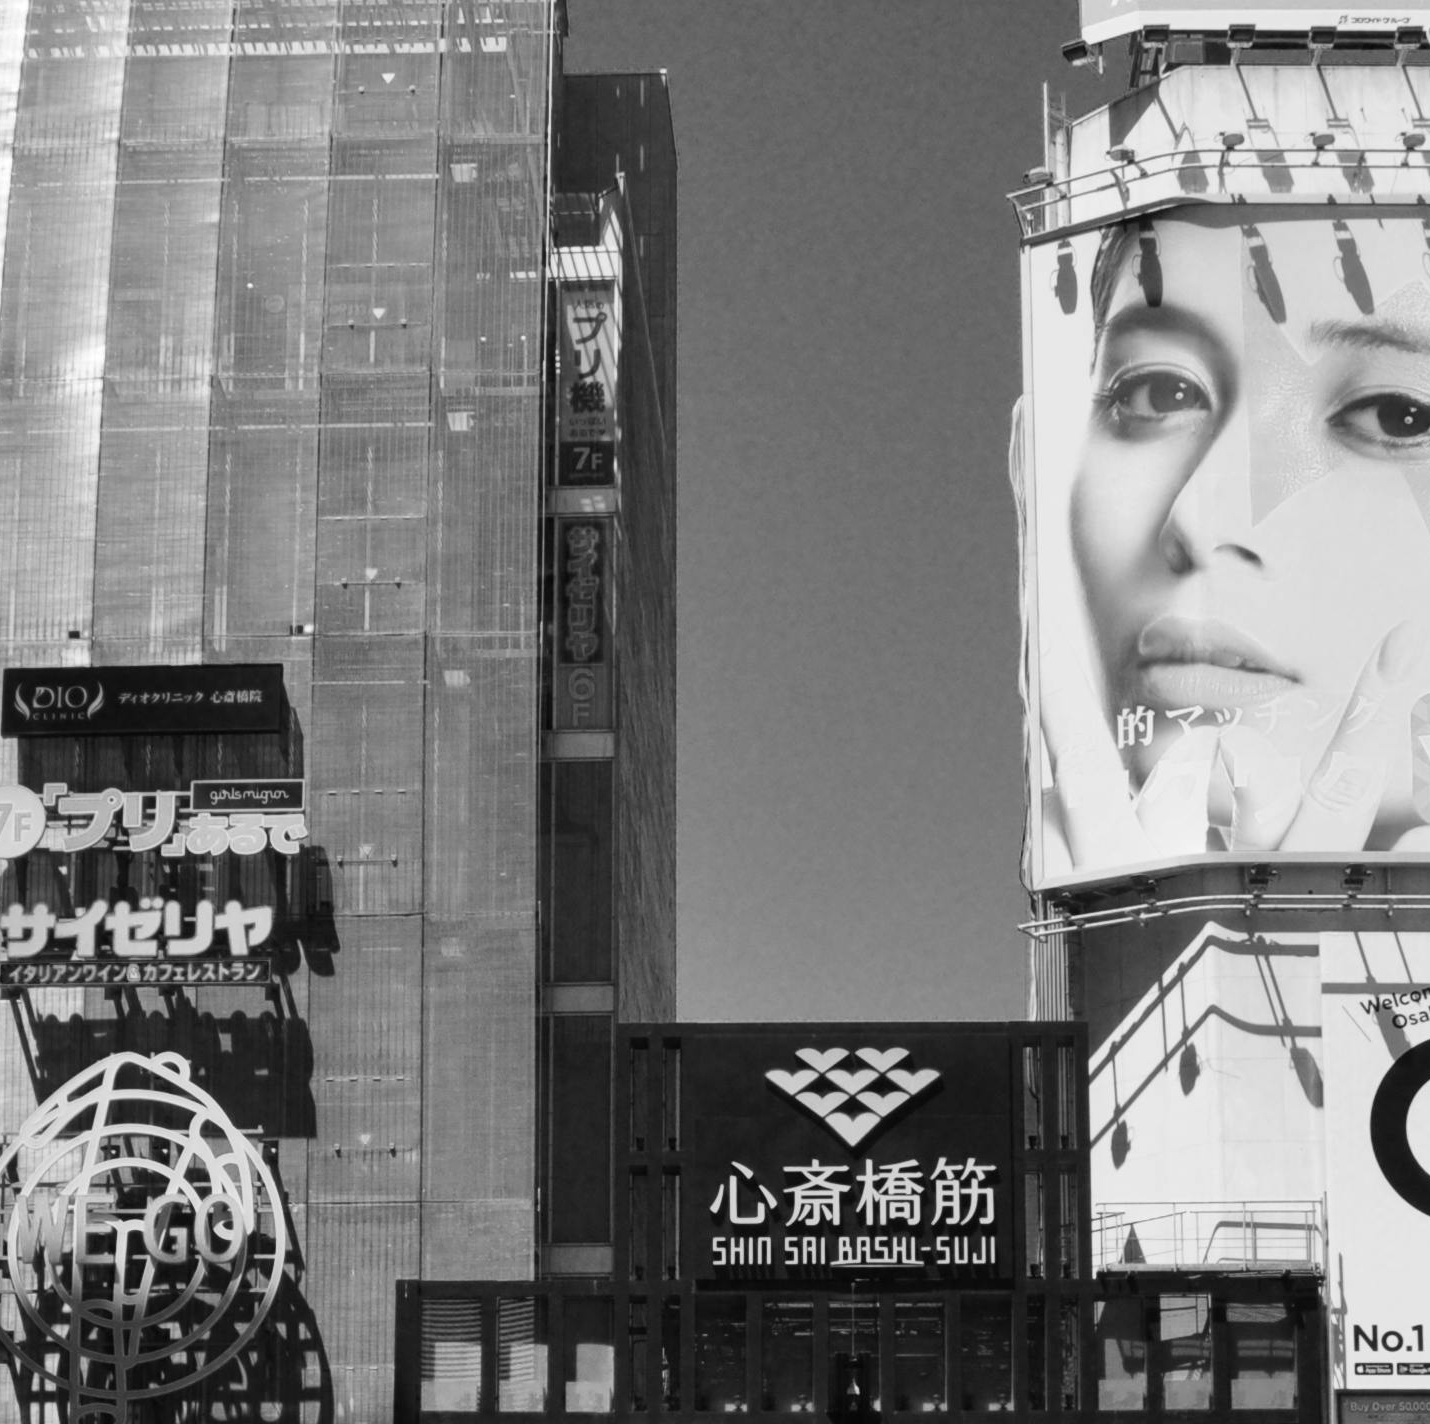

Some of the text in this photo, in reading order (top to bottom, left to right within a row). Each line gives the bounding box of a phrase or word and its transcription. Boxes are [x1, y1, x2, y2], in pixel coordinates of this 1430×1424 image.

[573, 447, 604, 471] 7F
[32, 685, 88, 710] DIO
[118, 691, 205, 705] ディオクリニック
[32, 711, 86, 721] CLINIC
[1, 898, 273, 958] サイゼリヤ
[709, 1156, 998, 1227] 心斎橋筋
[16, 1193, 245, 1265] WEGO
[712, 1236, 772, 1266] SHIN
[784, 1236, 826, 1265] SAI
[1351, 1323, 1425, 1353] No.1
[1351, 1401, 1370, 1412] Buy
[1372, 1401, 1395, 1411] Over
